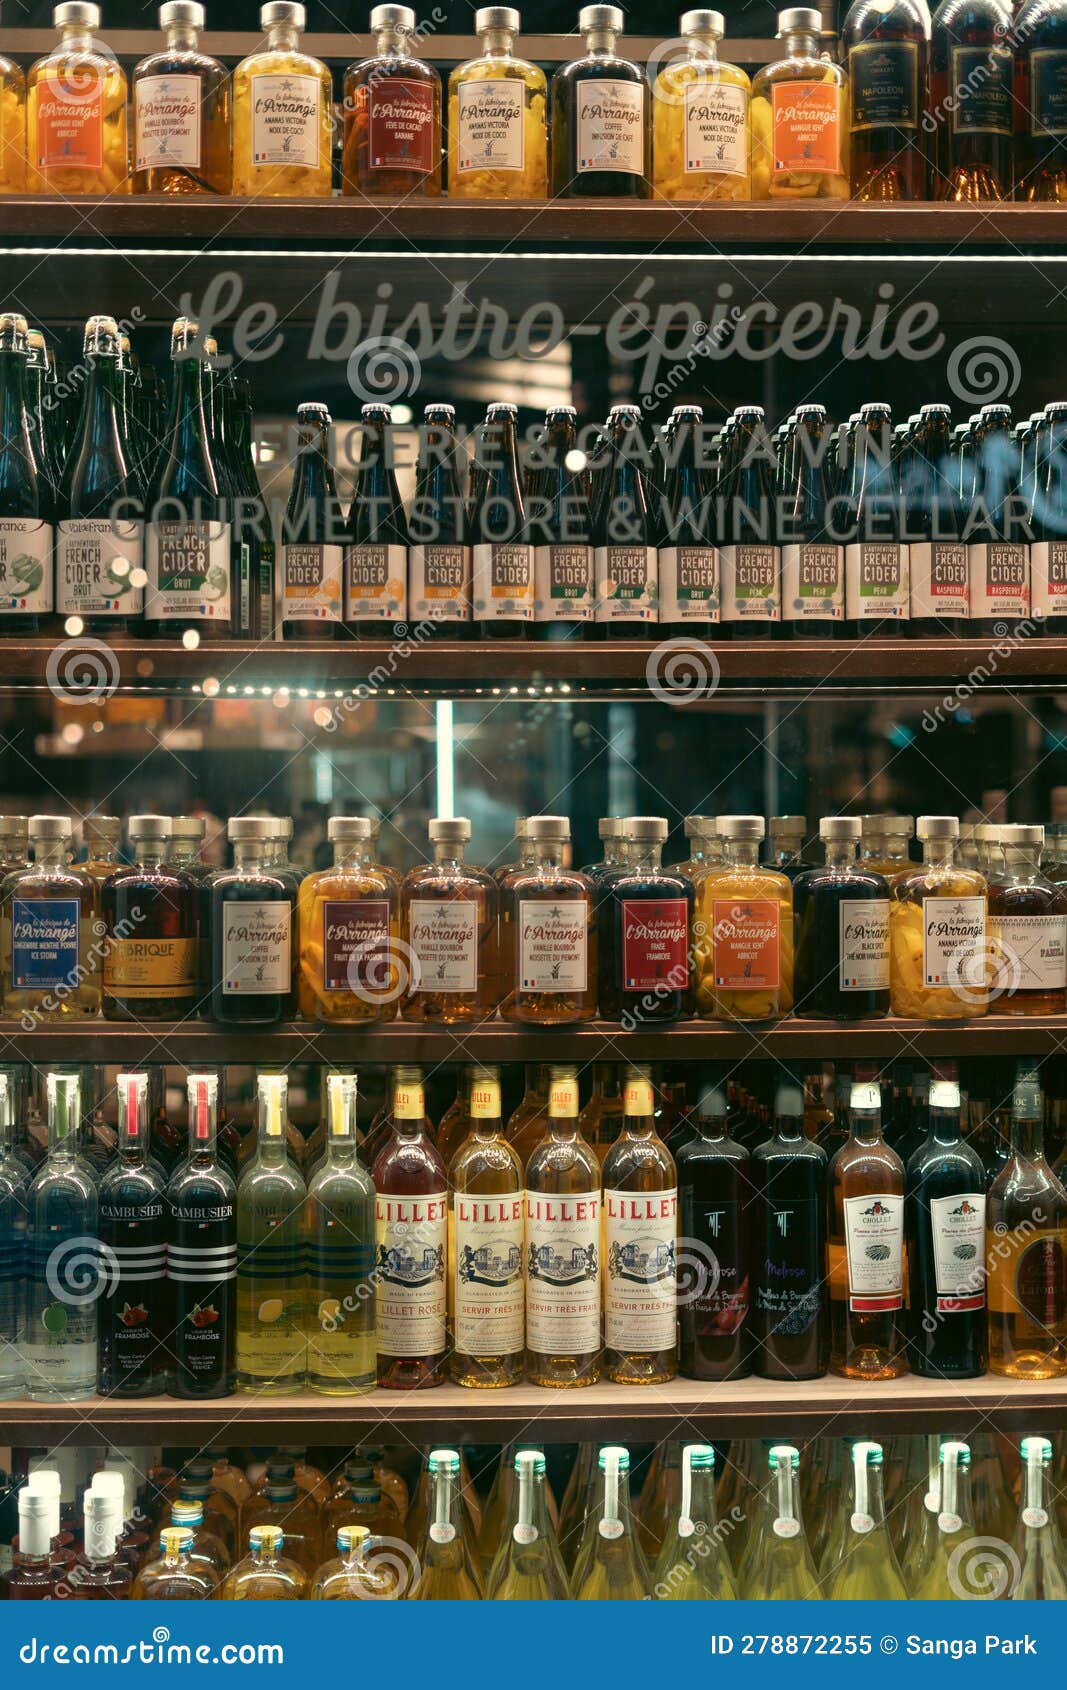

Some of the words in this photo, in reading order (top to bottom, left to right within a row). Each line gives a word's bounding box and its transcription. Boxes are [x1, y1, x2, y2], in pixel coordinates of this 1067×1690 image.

[255, 98, 316, 118] l'Arrangé
[372, 104, 432, 123] l'Arrangé
[460, 105, 520, 121] l'Arrangé
[581, 104, 640, 124] l'Arrangé
[775, 107, 838, 123] l'Arrangé
[688, 108, 744, 127] l'Arrangé
[174, 271, 285, 369] Le
[307, 271, 946, 394] bistro-épicerie
[524, 423, 557, 470] &
[576, 424, 727, 470] CAVE
[788, 424, 890, 470] VIN
[109, 496, 393, 543] GOURMET
[408, 496, 590, 543] STORE
[609, 496, 647, 543] &
[658, 496, 804, 542] WINE
[824, 495, 1036, 542] CELLAR
[162, 537, 206, 550] FRENCH
[65, 549, 101, 563] FRENCH
[162, 552, 206, 572] CIDER
[288, 555, 320, 567] FRENCH
[353, 555, 385, 566] FRENCH
[428, 555, 461, 567] FRENCH
[496, 554, 528, 566] FRENCH
[554, 556, 587, 567] FRENCH
[611, 556, 644, 568] FRENCH
[681, 557, 713, 569] FRENCH
[740, 555, 772, 566] FRENCH
[803, 554, 836, 566] FRENCH
[864, 553, 897, 565] FRENCH
[936, 553, 965, 565] FRENCH
[991, 553, 1024, 565] FRENCH
[65, 565, 101, 584] CIDER
[288, 568, 319, 583] CIDER
[353, 568, 384, 583] CIDER
[428, 569, 461, 584] CIDER
[496, 567, 528, 583] CIDER
[554, 569, 587, 584] CIDER
[611, 569, 644, 584] CIDER
[681, 570, 713, 585] CIDER
[740, 568, 772, 584] CIDER
[803, 567, 836, 583] CIDER
[864, 567, 897, 582] CIDER
[936, 566, 965, 582] CIDER
[991, 567, 1022, 582] CIDER
[73, 584, 91, 596] BRUT
[174, 578, 192, 588] BRUT
[873, 587, 887, 595] PEAR
[936, 587, 963, 595] RASPBERRY
[992, 587, 1021, 595] RASPBERRY
[14, 924, 76, 942] l'Arrangé
[227, 926, 288, 944] l'Arrangé
[327, 925, 387, 943] l'Arrangé
[413, 926, 473, 944] l'Arrangé
[524, 926, 583, 943] l'Arrangé
[626, 924, 686, 943] l'Arrangé
[928, 920, 983, 938] l'Arrangé
[101, 1204, 163, 1218] CAMBUSIER
[171, 1205, 232, 1219] CAMBUSIER
[376, 1201, 446, 1222] LILLET
[527, 1199, 598, 1221] LILLET
[608, 1197, 676, 1219] LILLET
[862, 1216, 891, 1224] CHOLLET
[382, 1307, 413, 1315] LILLET
[462, 1306, 490, 1314] SERVIR
